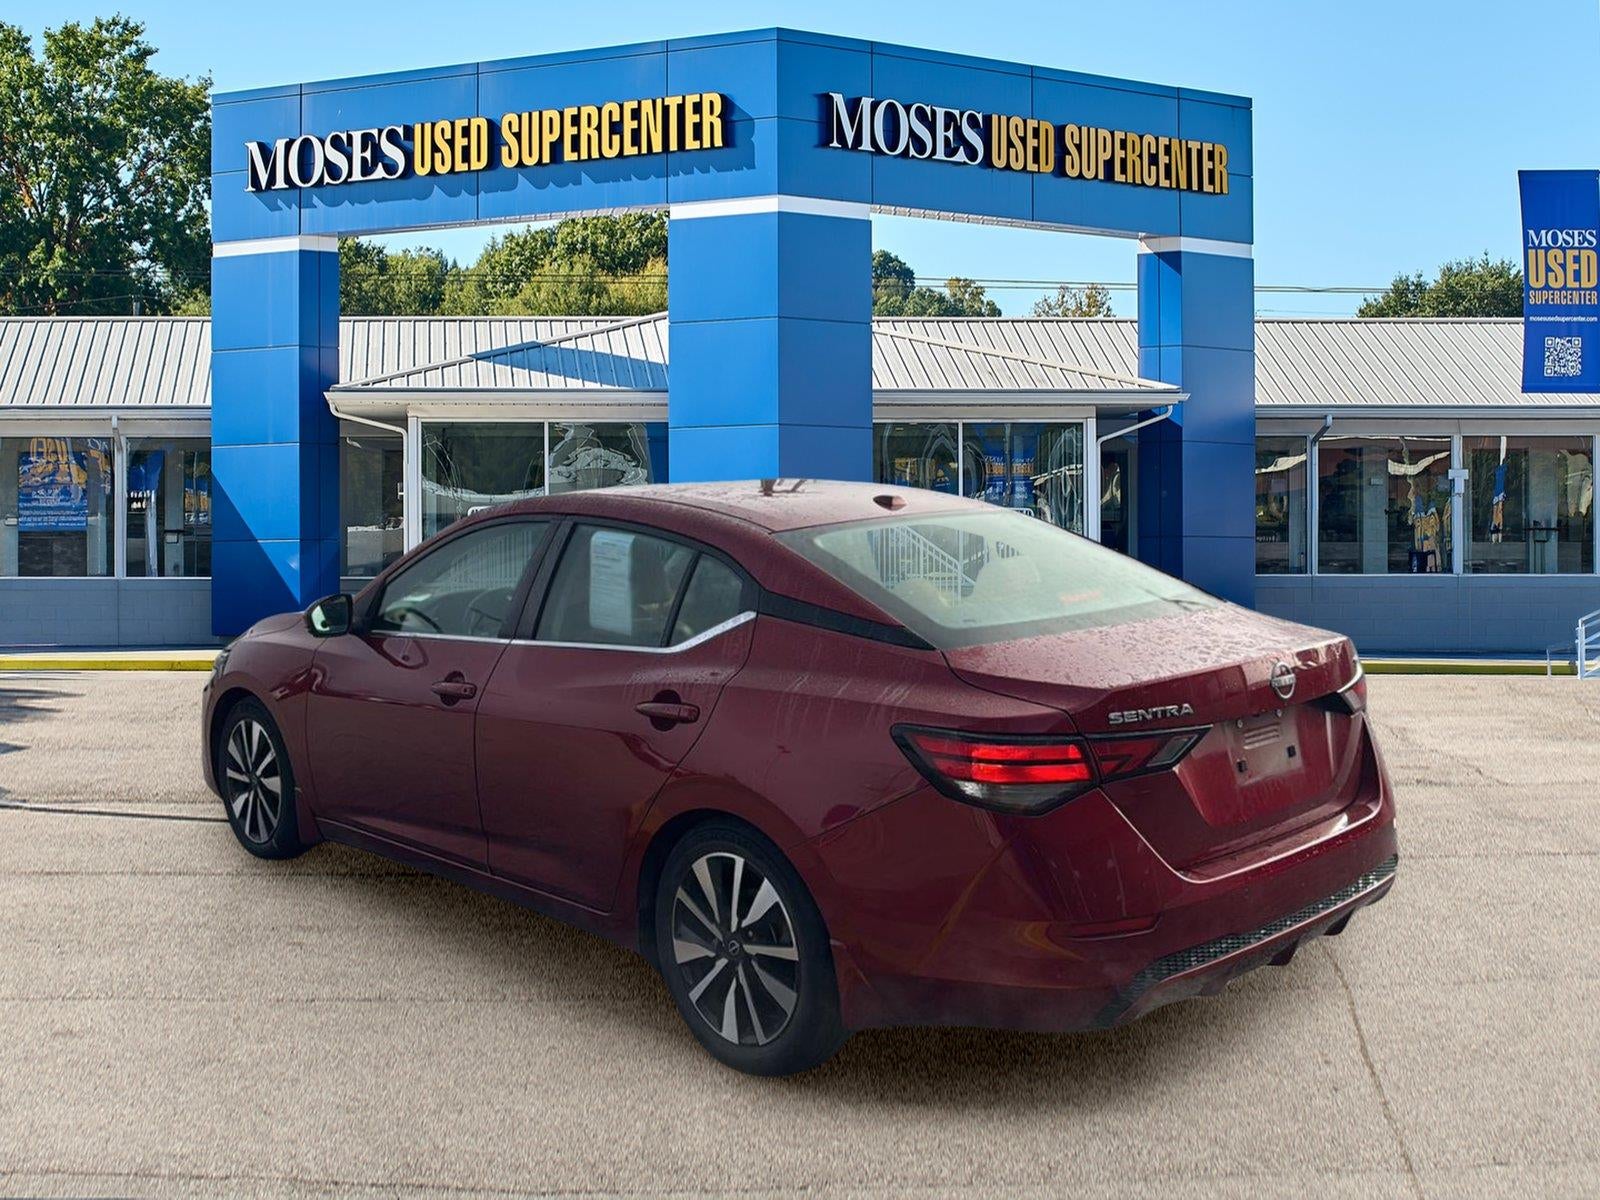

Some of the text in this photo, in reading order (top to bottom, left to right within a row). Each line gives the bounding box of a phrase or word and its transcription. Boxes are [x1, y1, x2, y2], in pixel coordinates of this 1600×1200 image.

[244, 91, 724, 192] MOSES USED SUPERCENTER
[828, 92, 1230, 195] MOSES USED SUPERCENTER
[1527, 229, 1597, 248] MOSES
[1528, 249, 1598, 289] USED
[1529, 290, 1598, 305] SUPERCENTER
[1108, 703, 1195, 725] SENTRA
